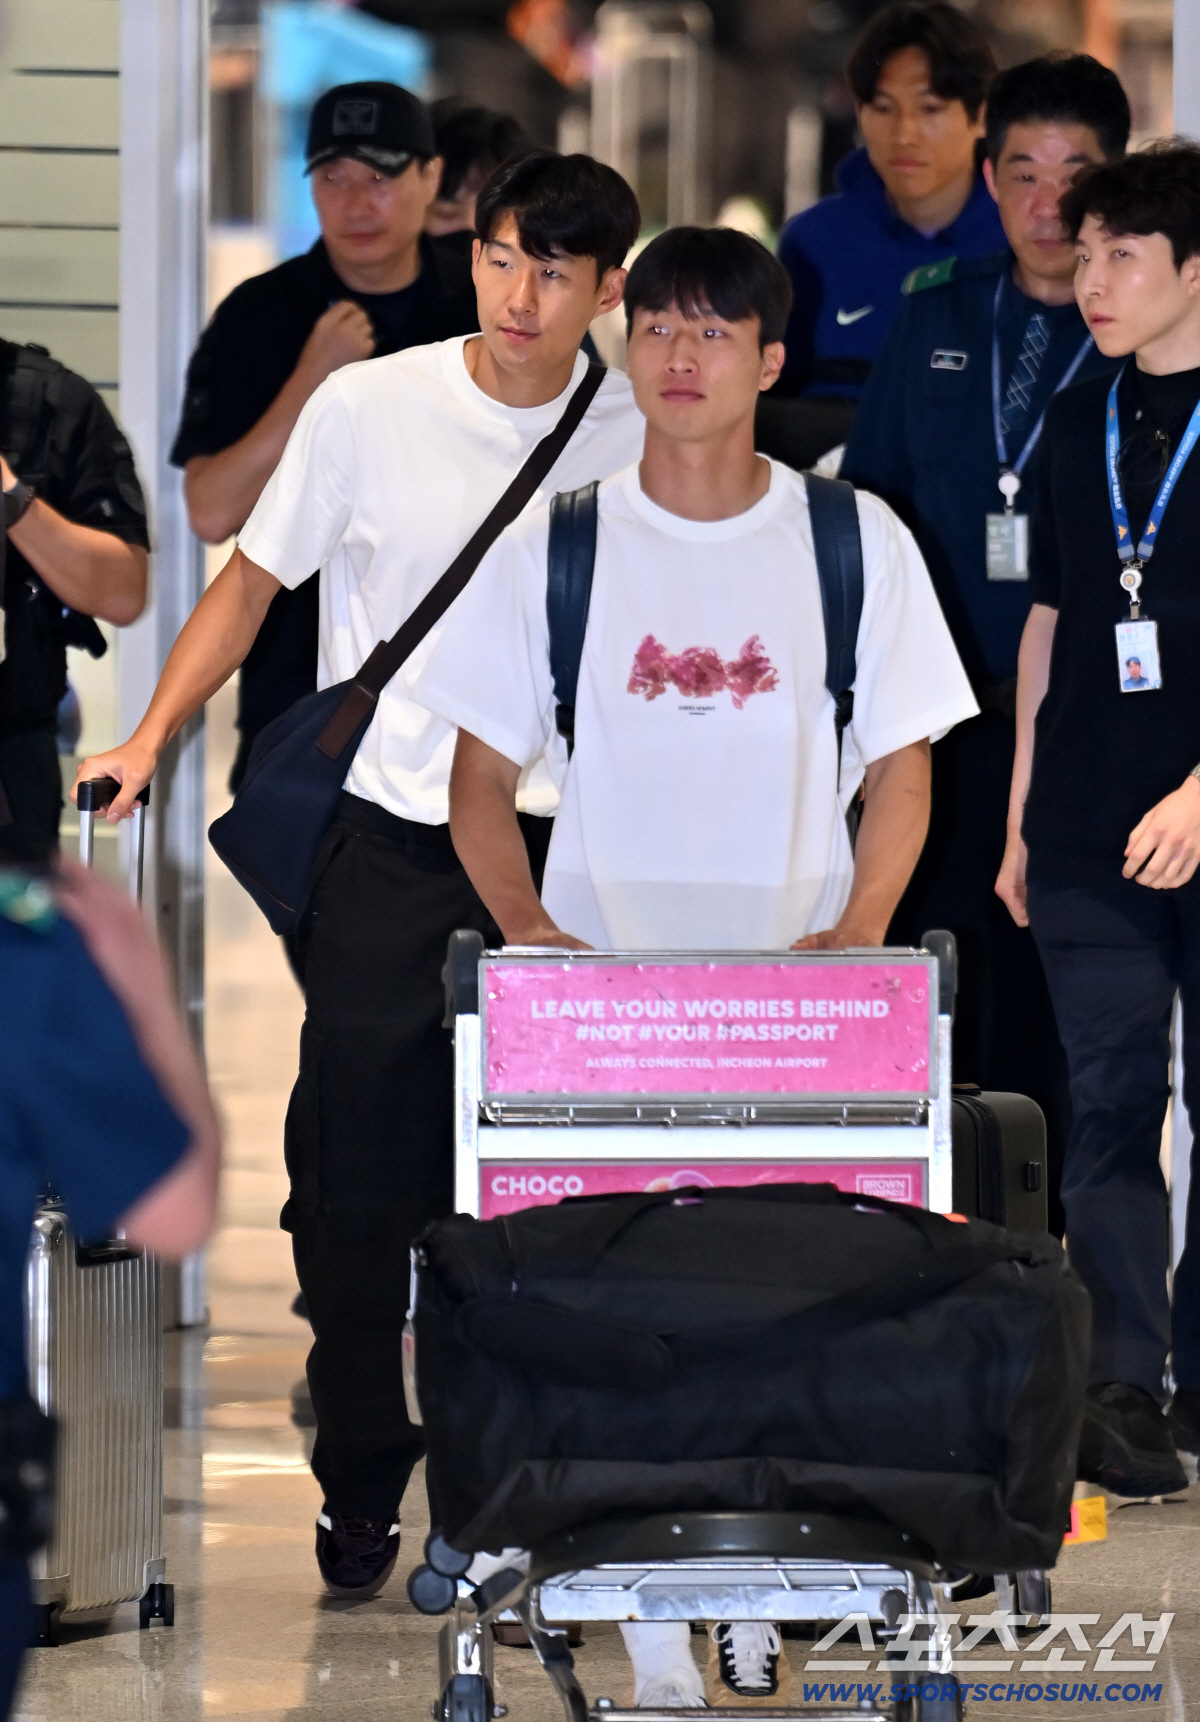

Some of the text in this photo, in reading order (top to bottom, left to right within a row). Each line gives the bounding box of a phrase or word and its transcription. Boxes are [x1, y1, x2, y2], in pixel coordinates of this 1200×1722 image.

[1168, 455, 1184, 481] AIRPORT
[1180, 431, 1195, 455] POLICE
[531, 1000, 889, 1019] LEAVE YOUR WORRIES BEHIND
[575, 1024, 838, 1041] #NOT #YOUR #PASSPORT
[586, 1057, 828, 1070] ALWAYS CONNECTED, INCHEON AIRPORT
[491, 1175, 583, 1196] CHOCO
[863, 1179, 905, 1190] BROWN
